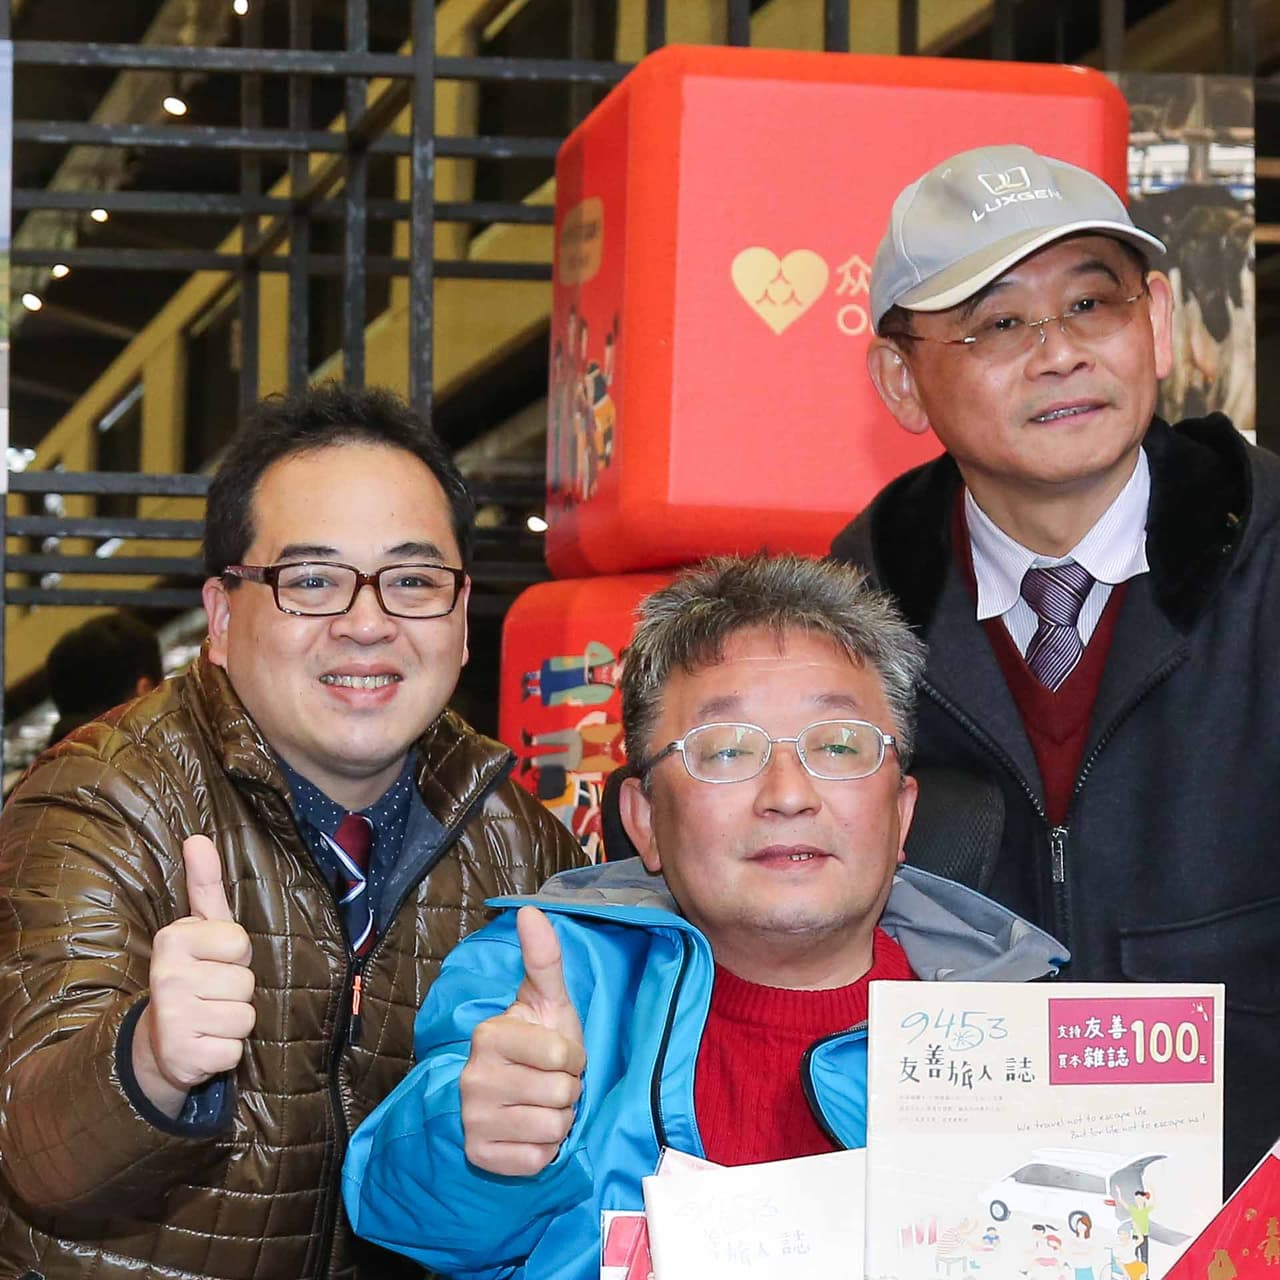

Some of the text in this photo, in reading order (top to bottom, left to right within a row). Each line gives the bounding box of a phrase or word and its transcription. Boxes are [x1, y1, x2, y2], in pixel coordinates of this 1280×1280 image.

[971, 187, 1062, 223] LUXGEN
[900, 1008, 1009, 1052] 9453
[898, 1043, 1036, 1090] 友善旅人誌
